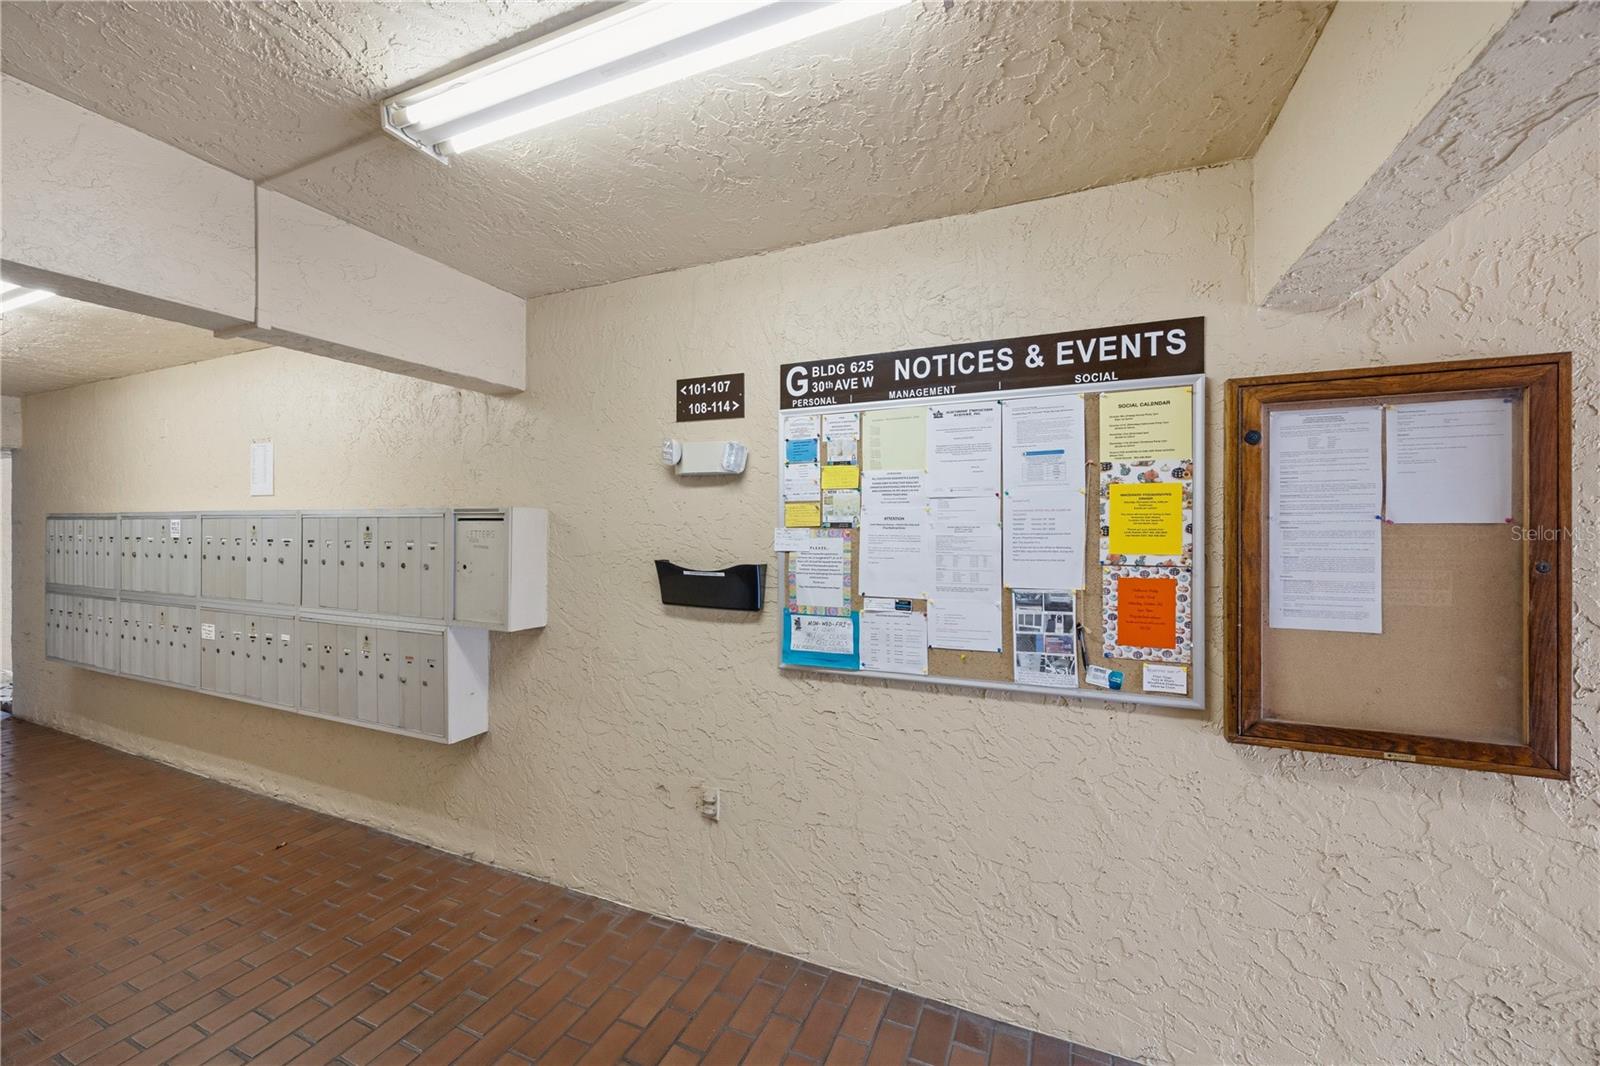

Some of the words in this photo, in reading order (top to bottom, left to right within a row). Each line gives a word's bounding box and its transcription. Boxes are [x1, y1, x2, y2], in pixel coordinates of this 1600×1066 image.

[894, 347, 1014, 381] NOTICES
[1024, 344, 1045, 368] &
[1056, 328, 1187, 366] EVENTS
[811, 364, 846, 378] BLDG
[850, 360, 874, 373] 625
[786, 365, 809, 397] G
[811, 380, 834, 393] 30th
[834, 377, 859, 391] AVE
[862, 376, 875, 388] W
[1074, 370, 1119, 384] SOCIAL
[688, 380, 731, 395] 101-107
[888, 385, 957, 400] MANAGEMENT
[688, 401, 731, 415] 108-114
[792, 396, 837, 408] PERSONAL
